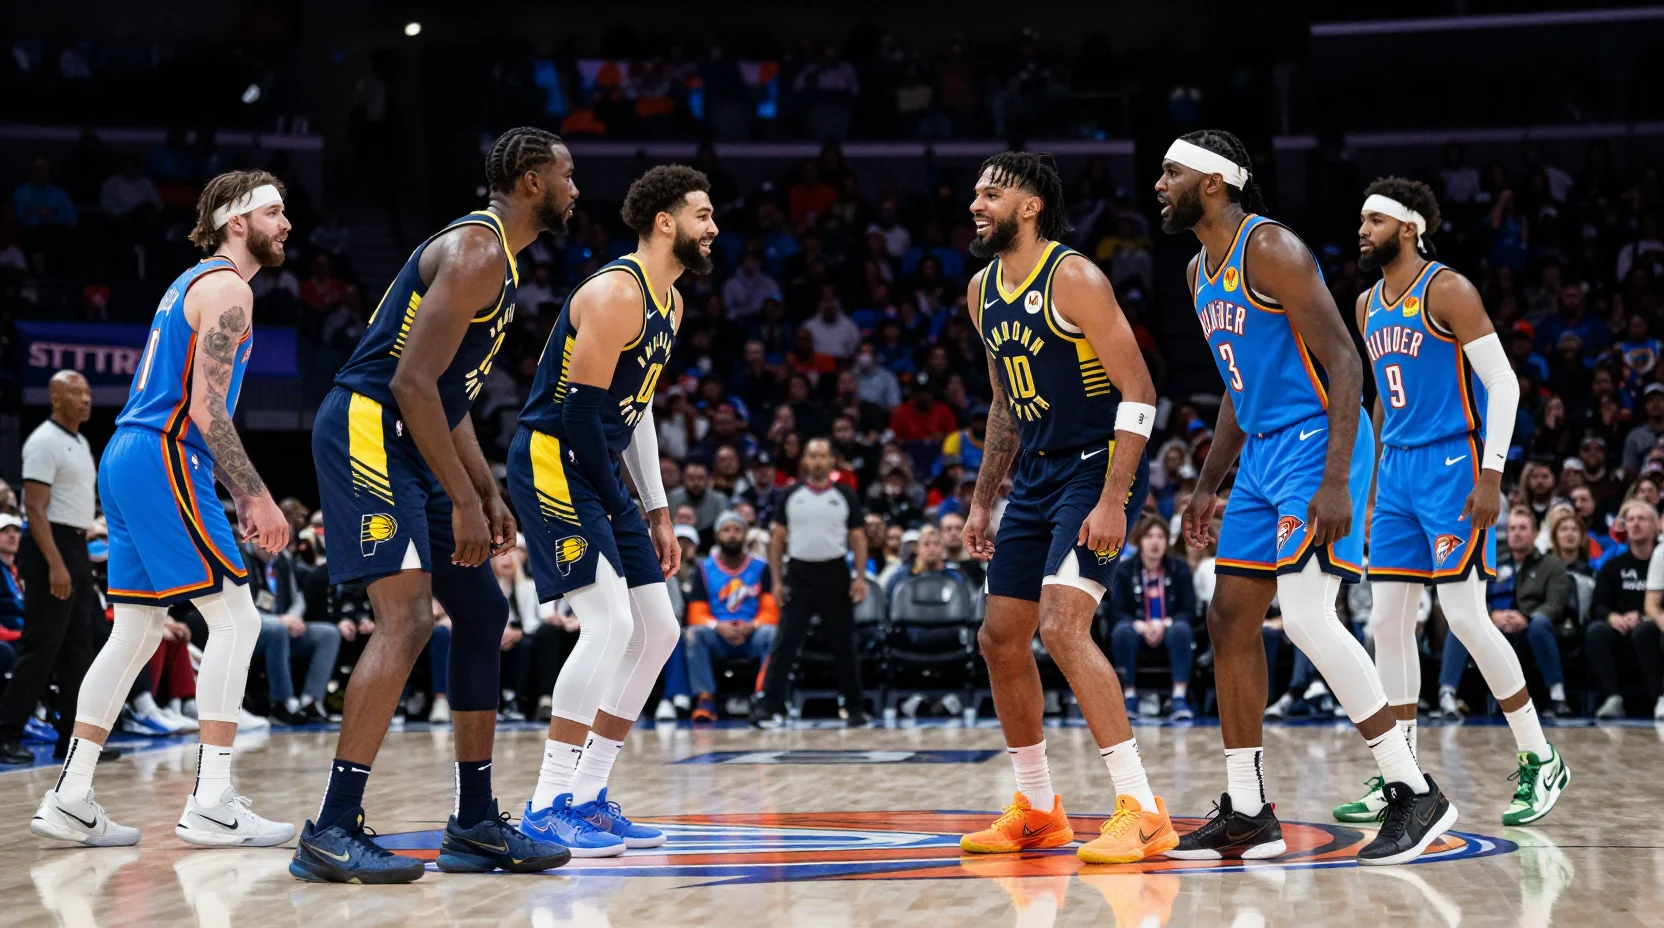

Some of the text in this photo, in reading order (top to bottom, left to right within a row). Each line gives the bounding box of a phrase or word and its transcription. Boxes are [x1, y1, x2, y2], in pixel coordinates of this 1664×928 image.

[636, 363, 663, 403] 0
[1003, 355, 1036, 399] 10
[1217, 342, 1244, 393] 3
[1385, 364, 1406, 409] 9
